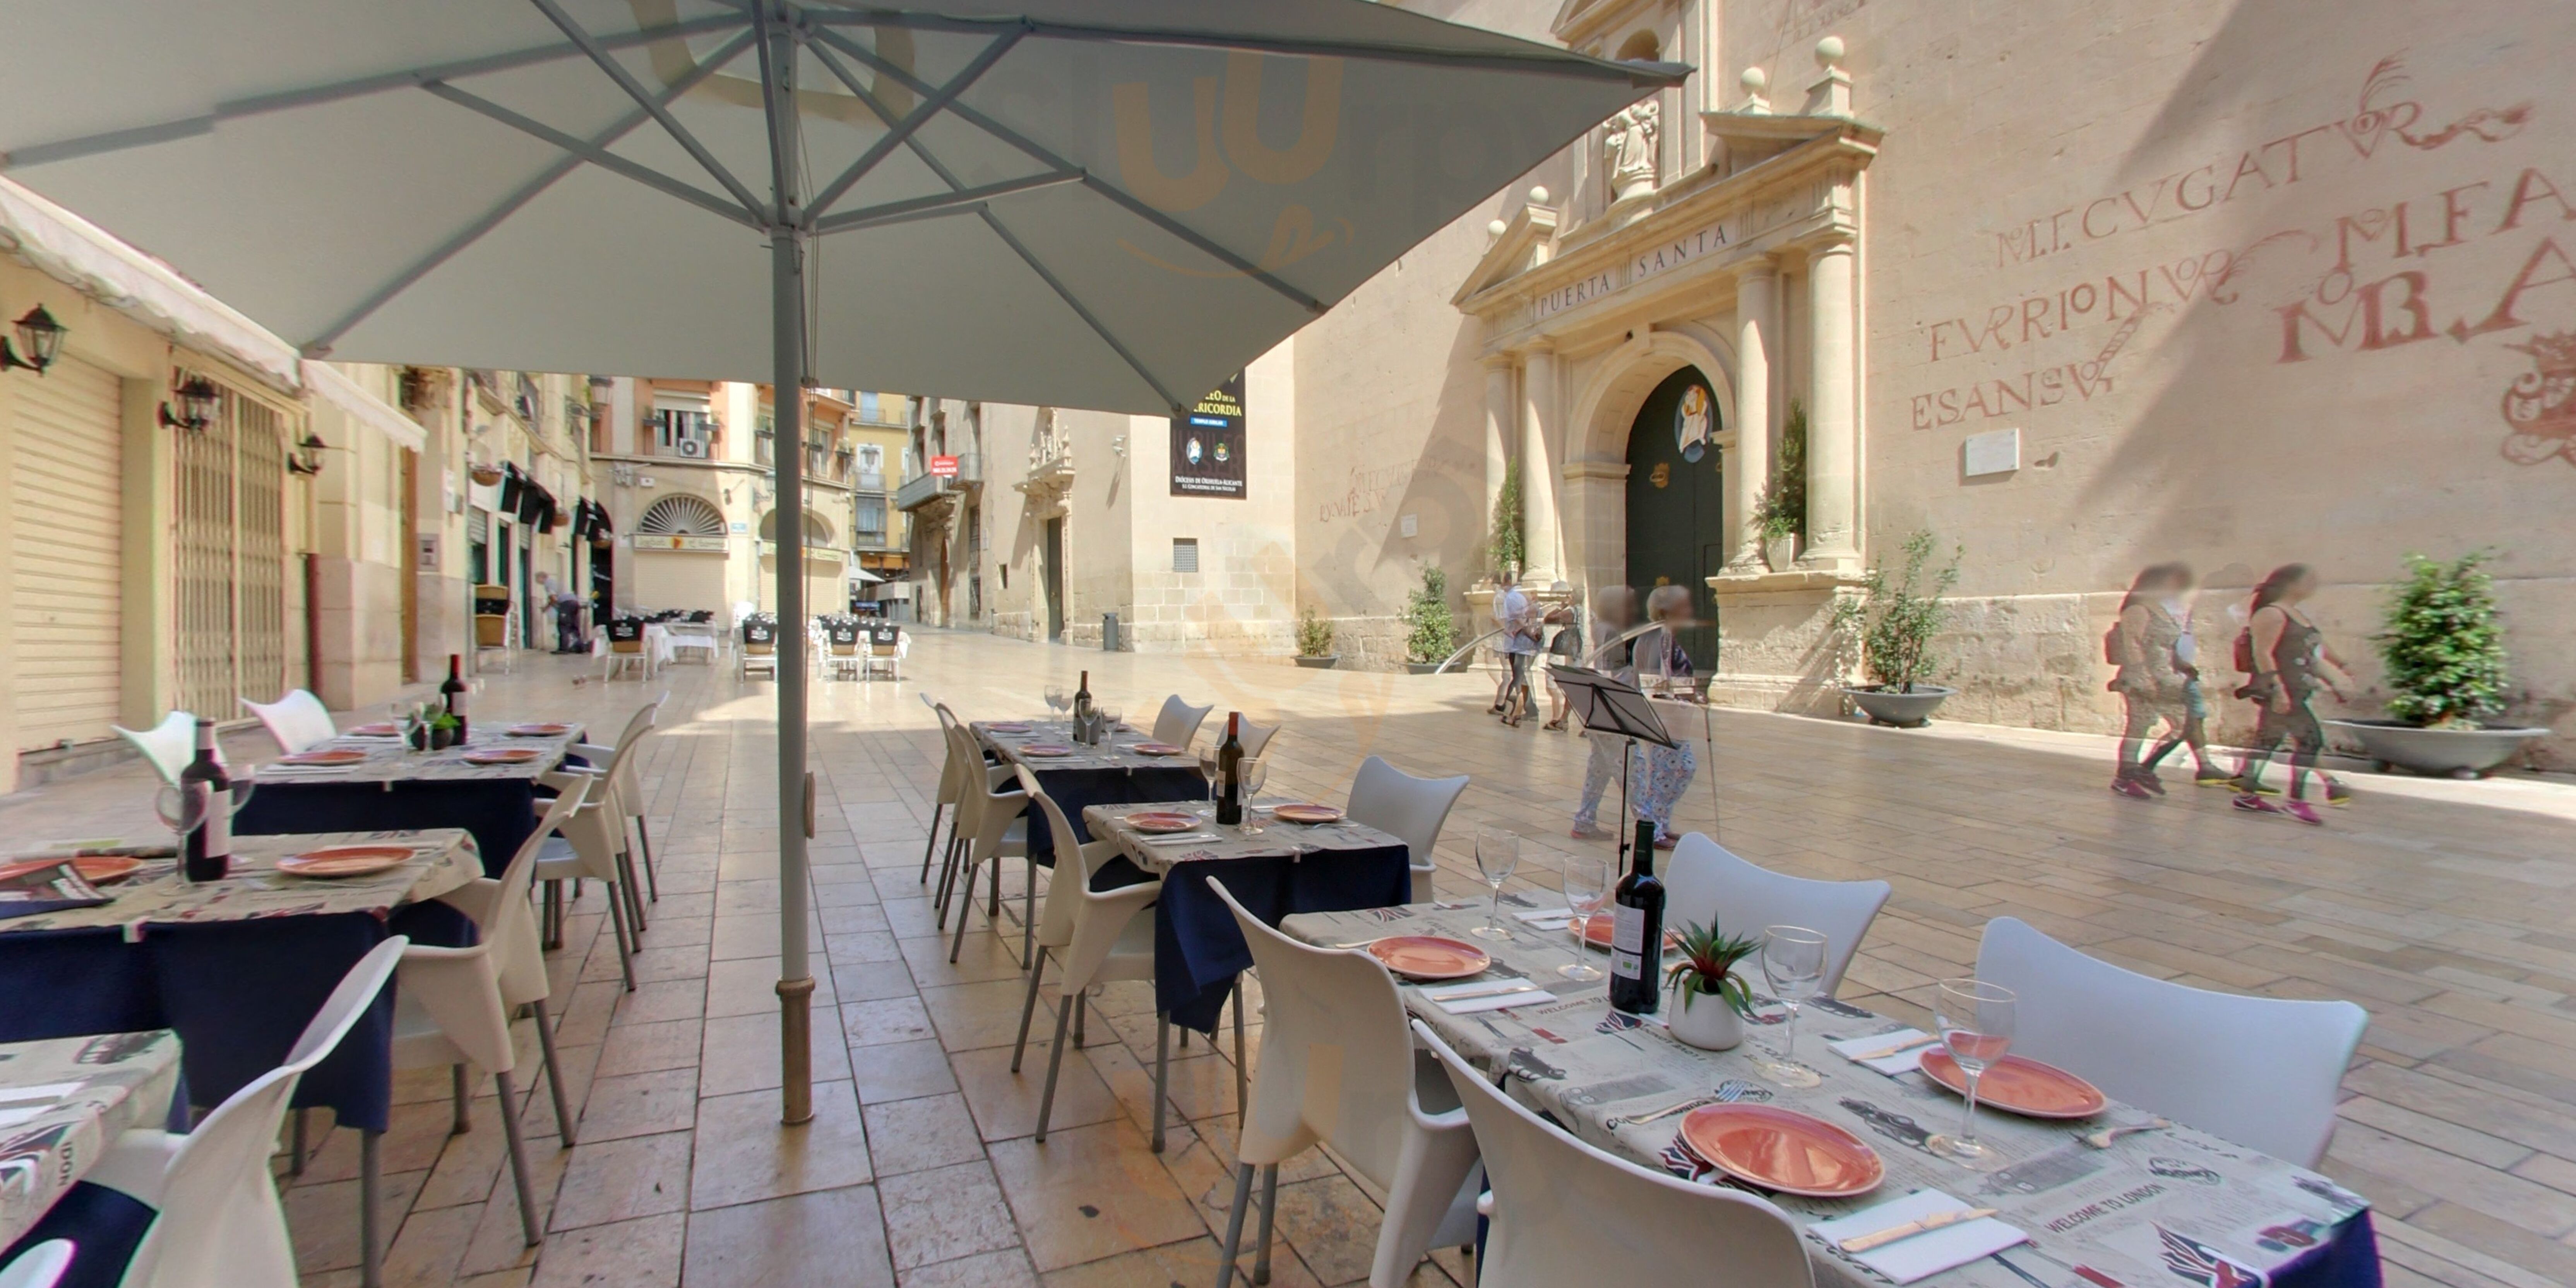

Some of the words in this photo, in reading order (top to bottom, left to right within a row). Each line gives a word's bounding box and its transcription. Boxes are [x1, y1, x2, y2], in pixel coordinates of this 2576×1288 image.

[1540, 273, 1610, 316] PUERTA
[1638, 224, 1726, 277] SANTA
[1536, 1000, 1588, 1015] WELCOME
[2043, 1204, 2110, 1233] WELCOME
[2099, 1198, 2126, 1210] TO
[2116, 1182, 2168, 1205] LONDON
